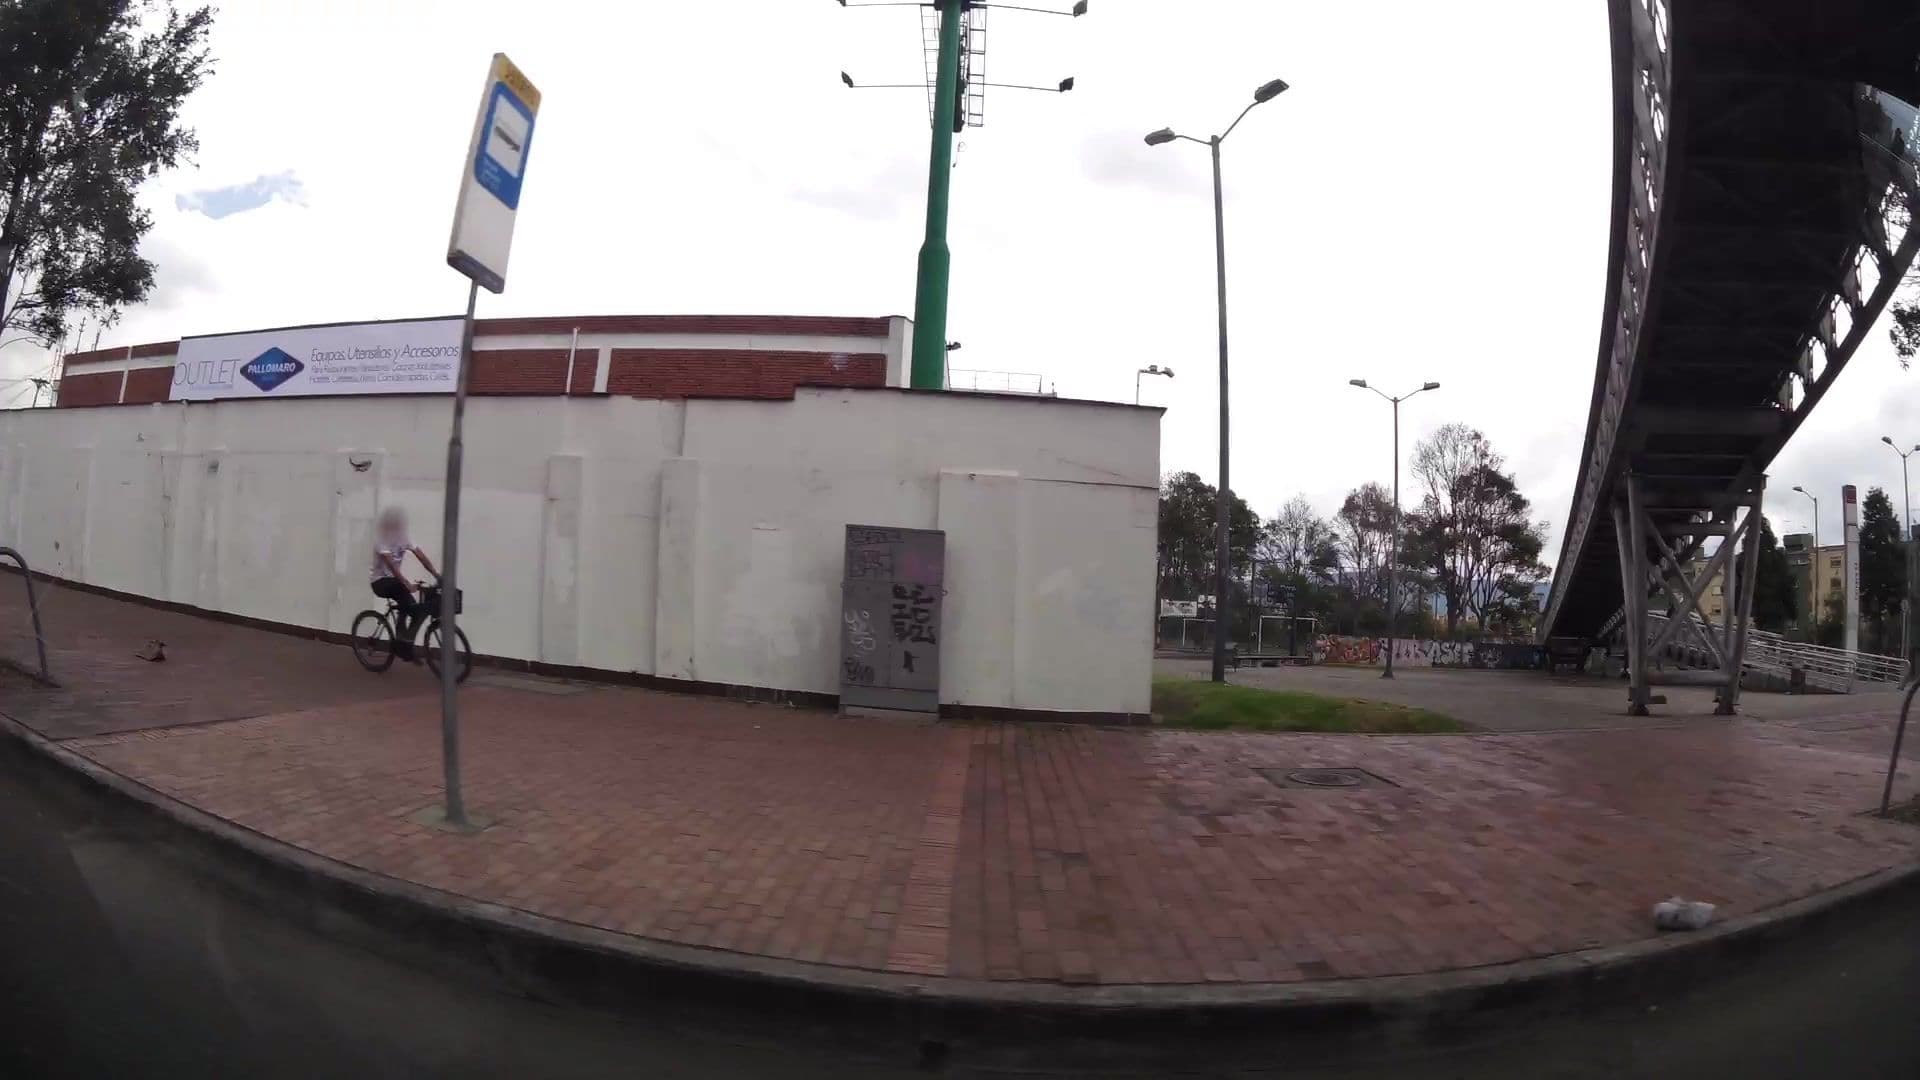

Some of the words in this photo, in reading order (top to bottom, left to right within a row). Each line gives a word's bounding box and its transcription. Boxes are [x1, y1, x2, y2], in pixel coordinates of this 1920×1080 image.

[393, 350, 400, 362] y
[401, 344, 460, 358] Accesorios
[174, 359, 240, 385] OUTLET
[247, 362, 296, 374] PALLOMARO
